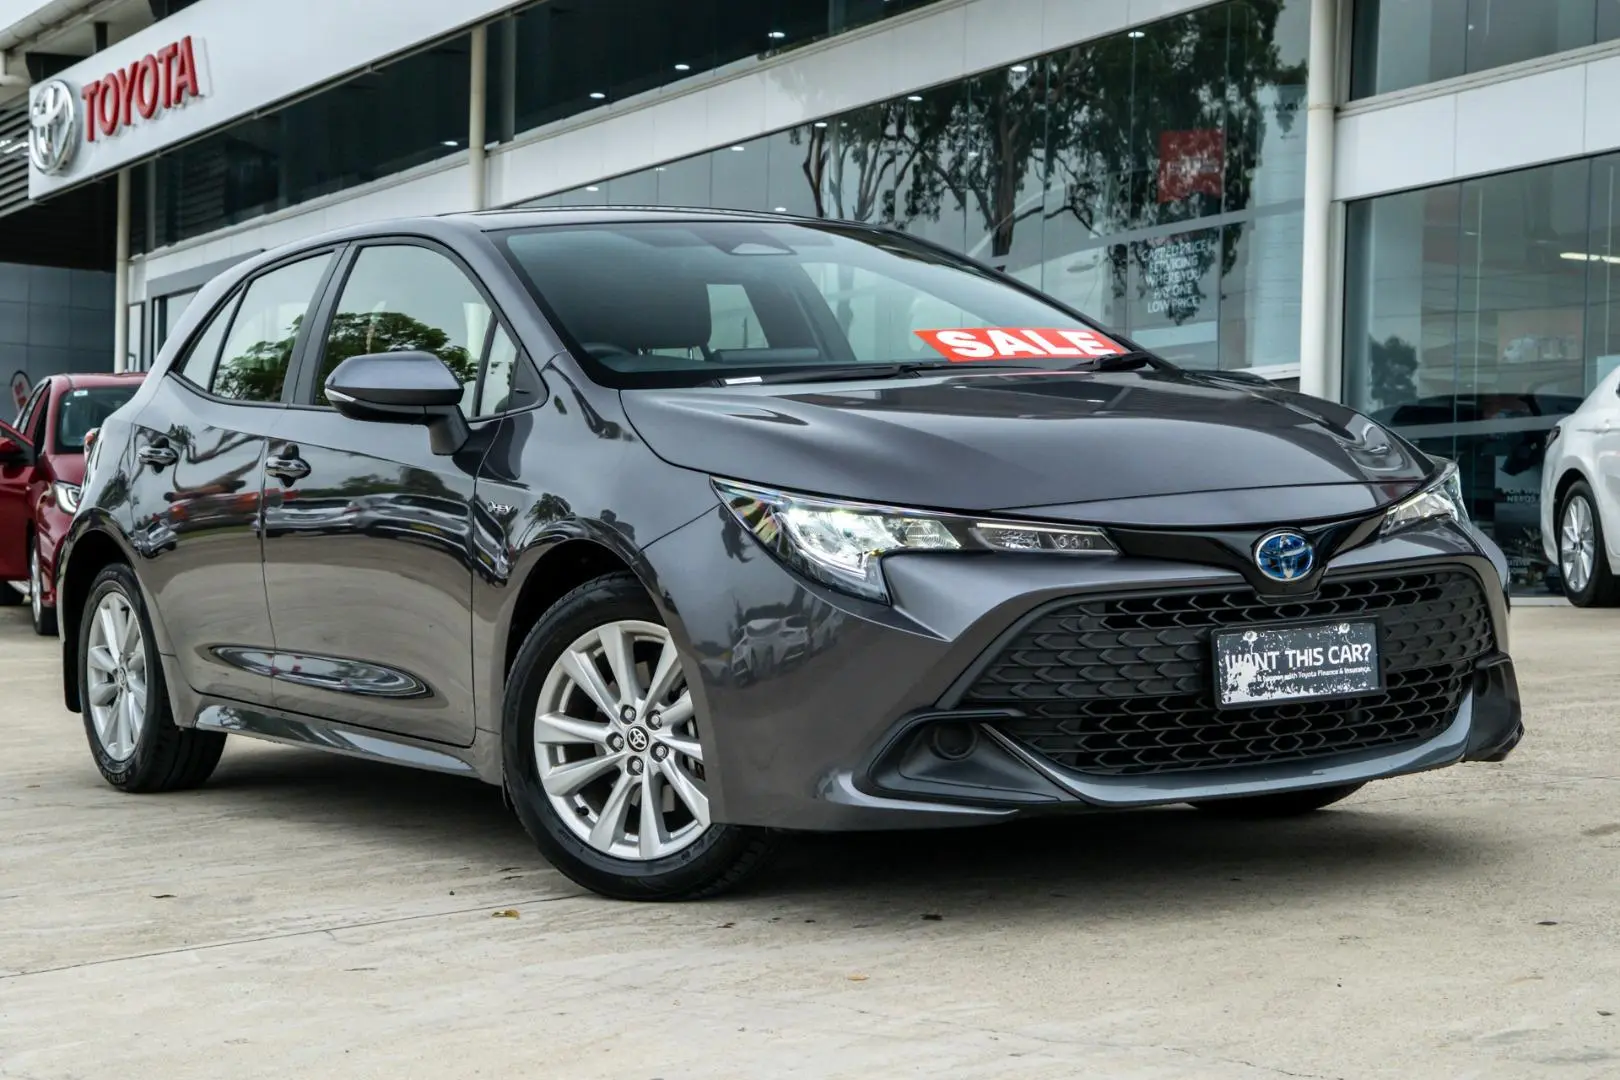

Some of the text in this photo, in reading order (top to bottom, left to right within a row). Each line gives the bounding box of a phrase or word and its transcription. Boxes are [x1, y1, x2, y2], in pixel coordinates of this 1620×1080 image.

[81, 35, 199, 142] TOYOTA
[1172, 283, 1193, 296] ONE
[1147, 299, 1169, 313] LOW
[936, 329, 1116, 358] SALE
[1225, 643, 1372, 671] WANT THIS CAR?
[1298, 671, 1317, 679] Toyota
